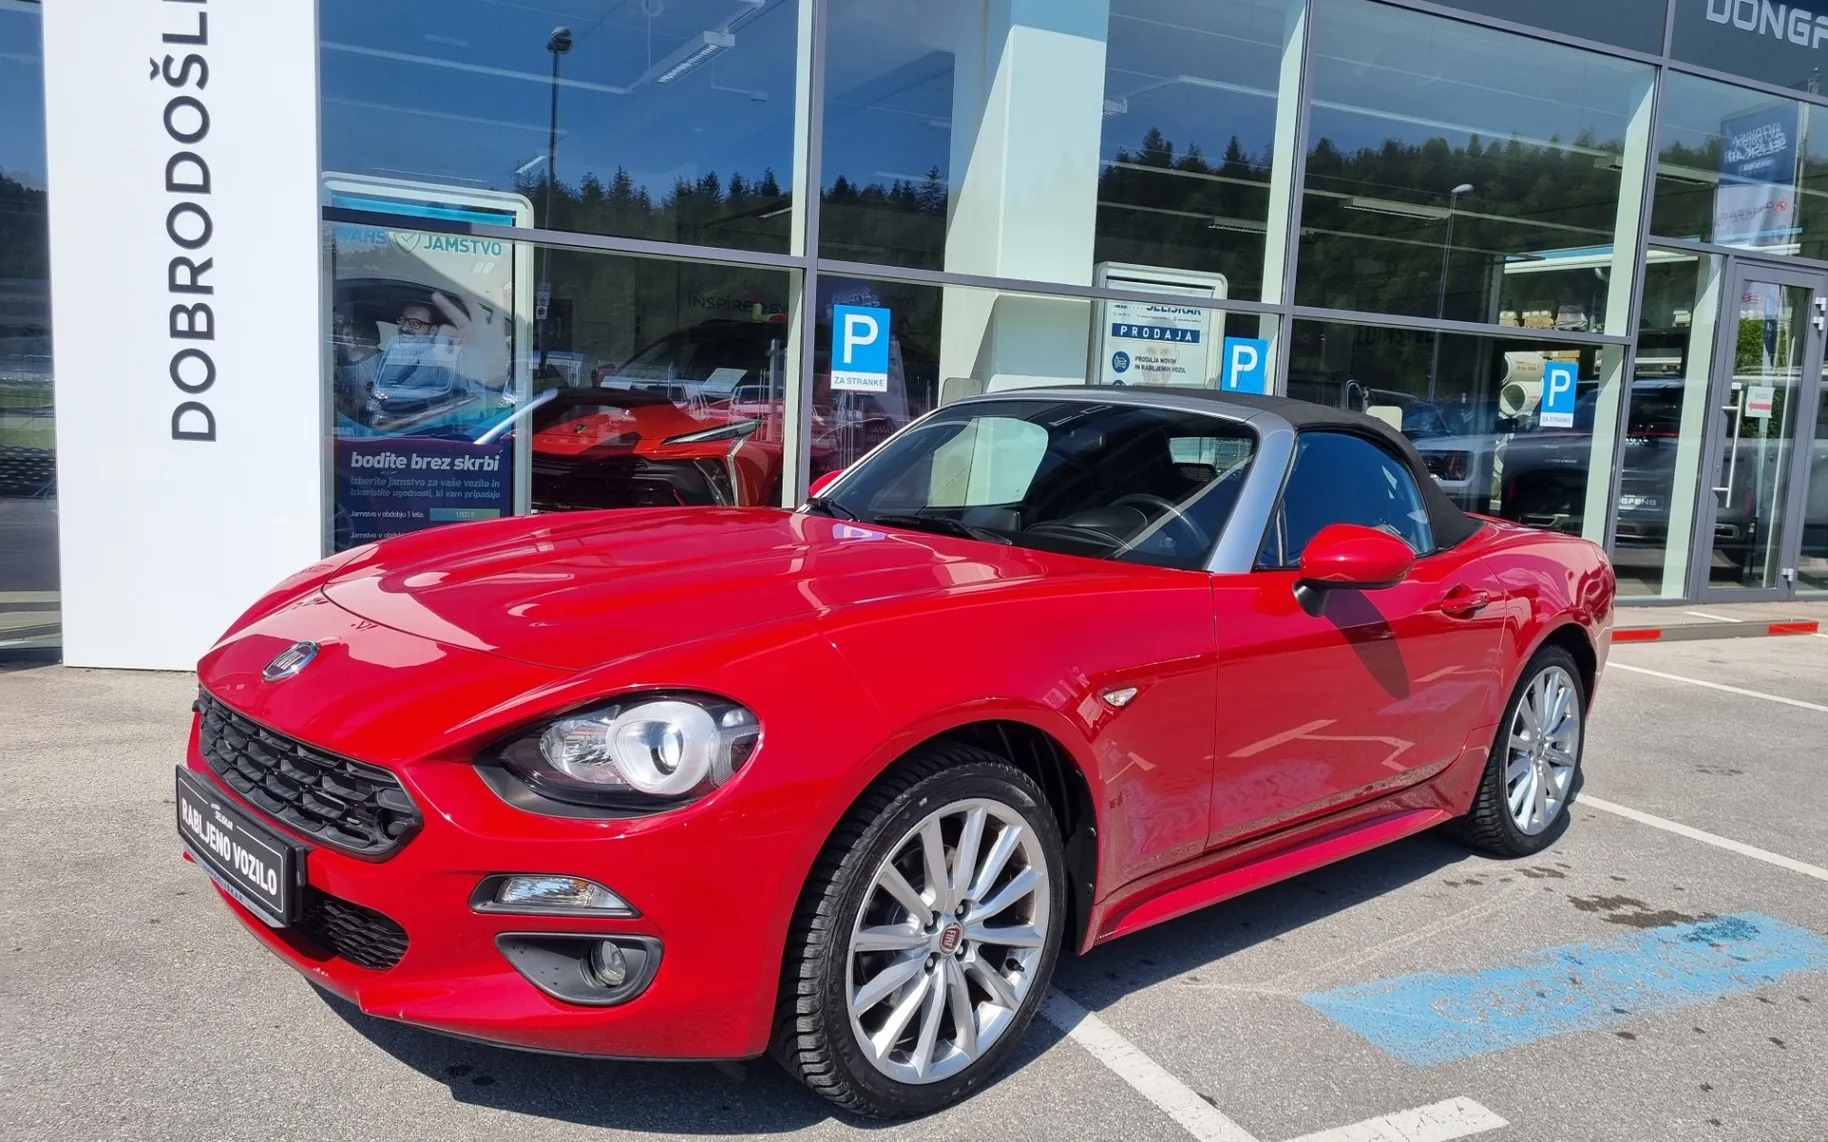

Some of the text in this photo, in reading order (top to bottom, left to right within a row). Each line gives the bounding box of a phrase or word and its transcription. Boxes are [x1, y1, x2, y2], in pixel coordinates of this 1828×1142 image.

[150, 0, 217, 442] DOBRODOŠL
[424, 236, 502, 256] JAMSTVO
[843, 313, 879, 364] P
[1120, 325, 1192, 342] PRODAJA
[1135, 356, 1160, 364] PRODAJA
[1140, 364, 1171, 373] RABLJENIH
[1230, 345, 1258, 388] P
[834, 376, 885, 387] ZA STRANKE
[1548, 369, 1571, 407] P
[351, 452, 500, 471] bodite brez skrbi
[350, 476, 386, 486] izberite
[388, 477, 425, 487] jamstvo
[441, 477, 462, 487] vaše
[464, 479, 490, 488] vozilo
[491, 479, 500, 488] in
[393, 489, 433, 498] ugodnosti,
[464, 491, 500, 499] pripadajo
[382, 510, 406, 519] obdobju
[350, 531, 377, 539] Jamstvo
[182, 797, 278, 896] RABLJENO VOZILO
[943, 929, 957, 948] FIAT
